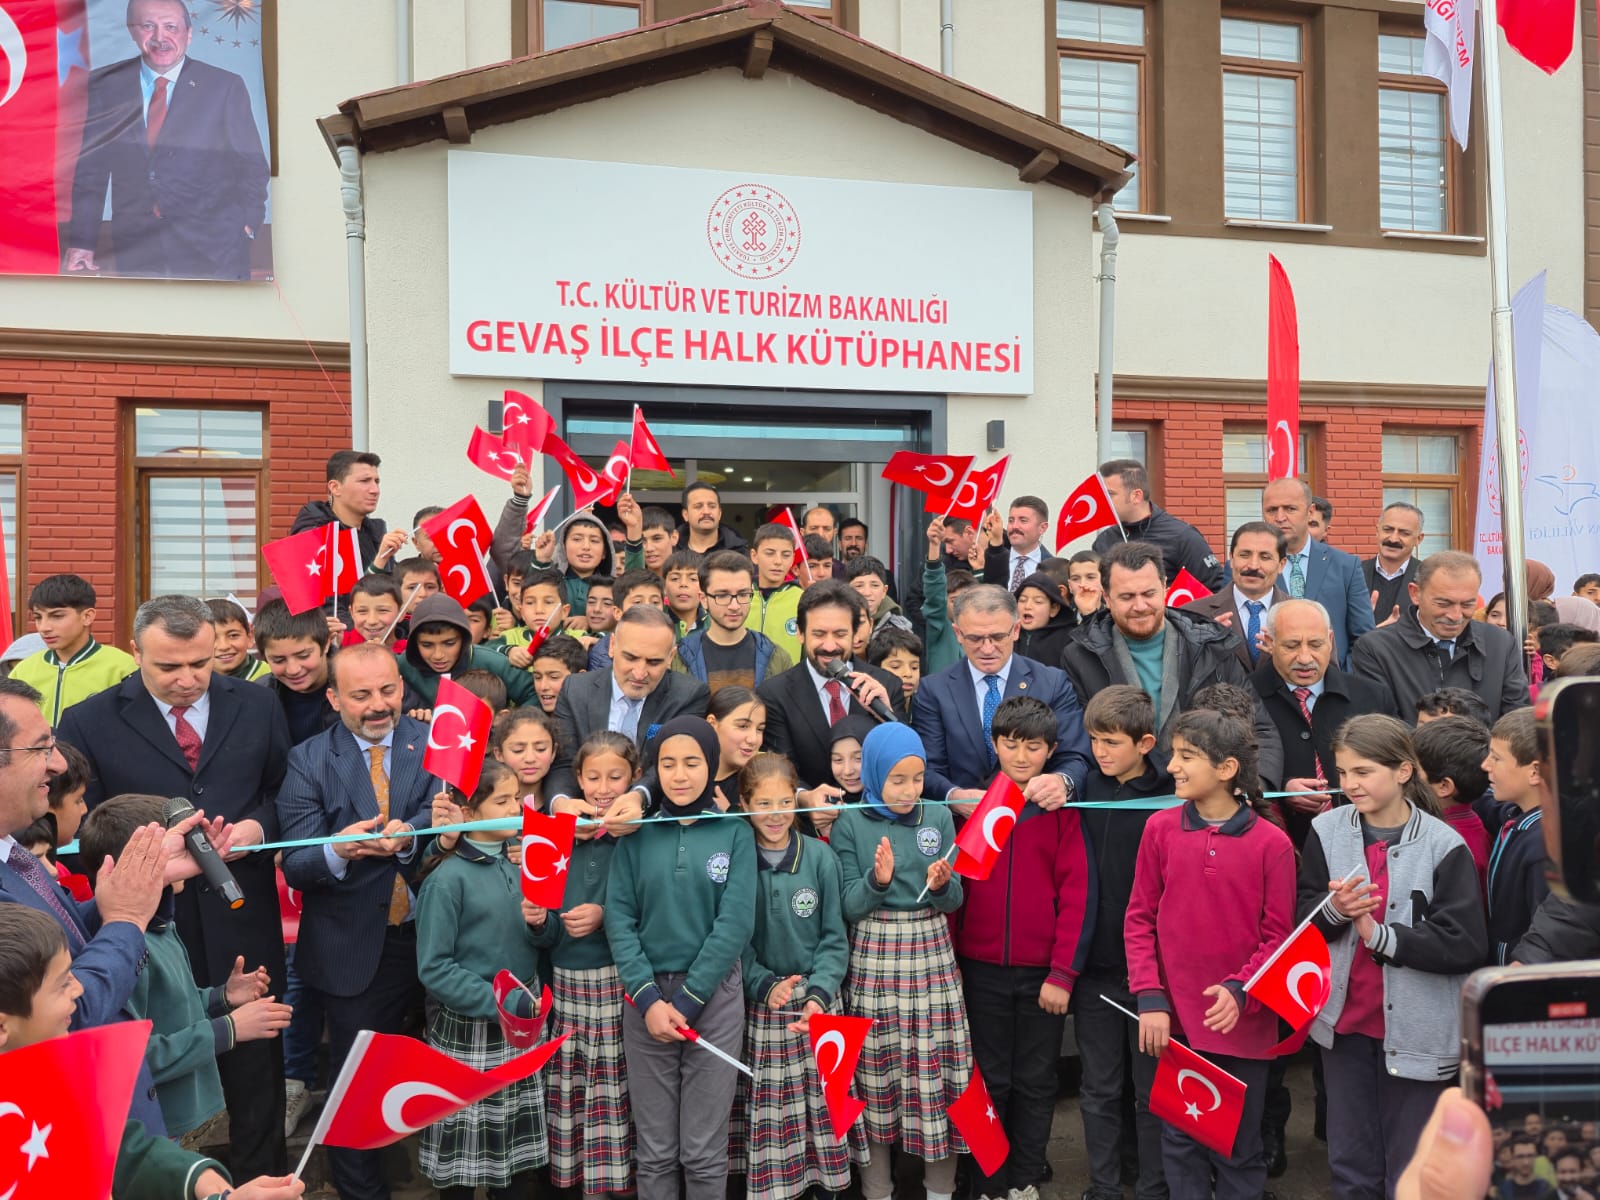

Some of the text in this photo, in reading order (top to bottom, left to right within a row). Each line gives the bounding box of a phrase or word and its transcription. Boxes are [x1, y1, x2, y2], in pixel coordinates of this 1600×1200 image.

[555, 278, 948, 325] T.C. KÜLTÜR VE TURİZM BAKANLIĞI
[466, 317, 1021, 374] GEVAŞ İLÇE HALK KÜTÜPHANESİ
[1525, 1035, 1570, 1053] HALK
